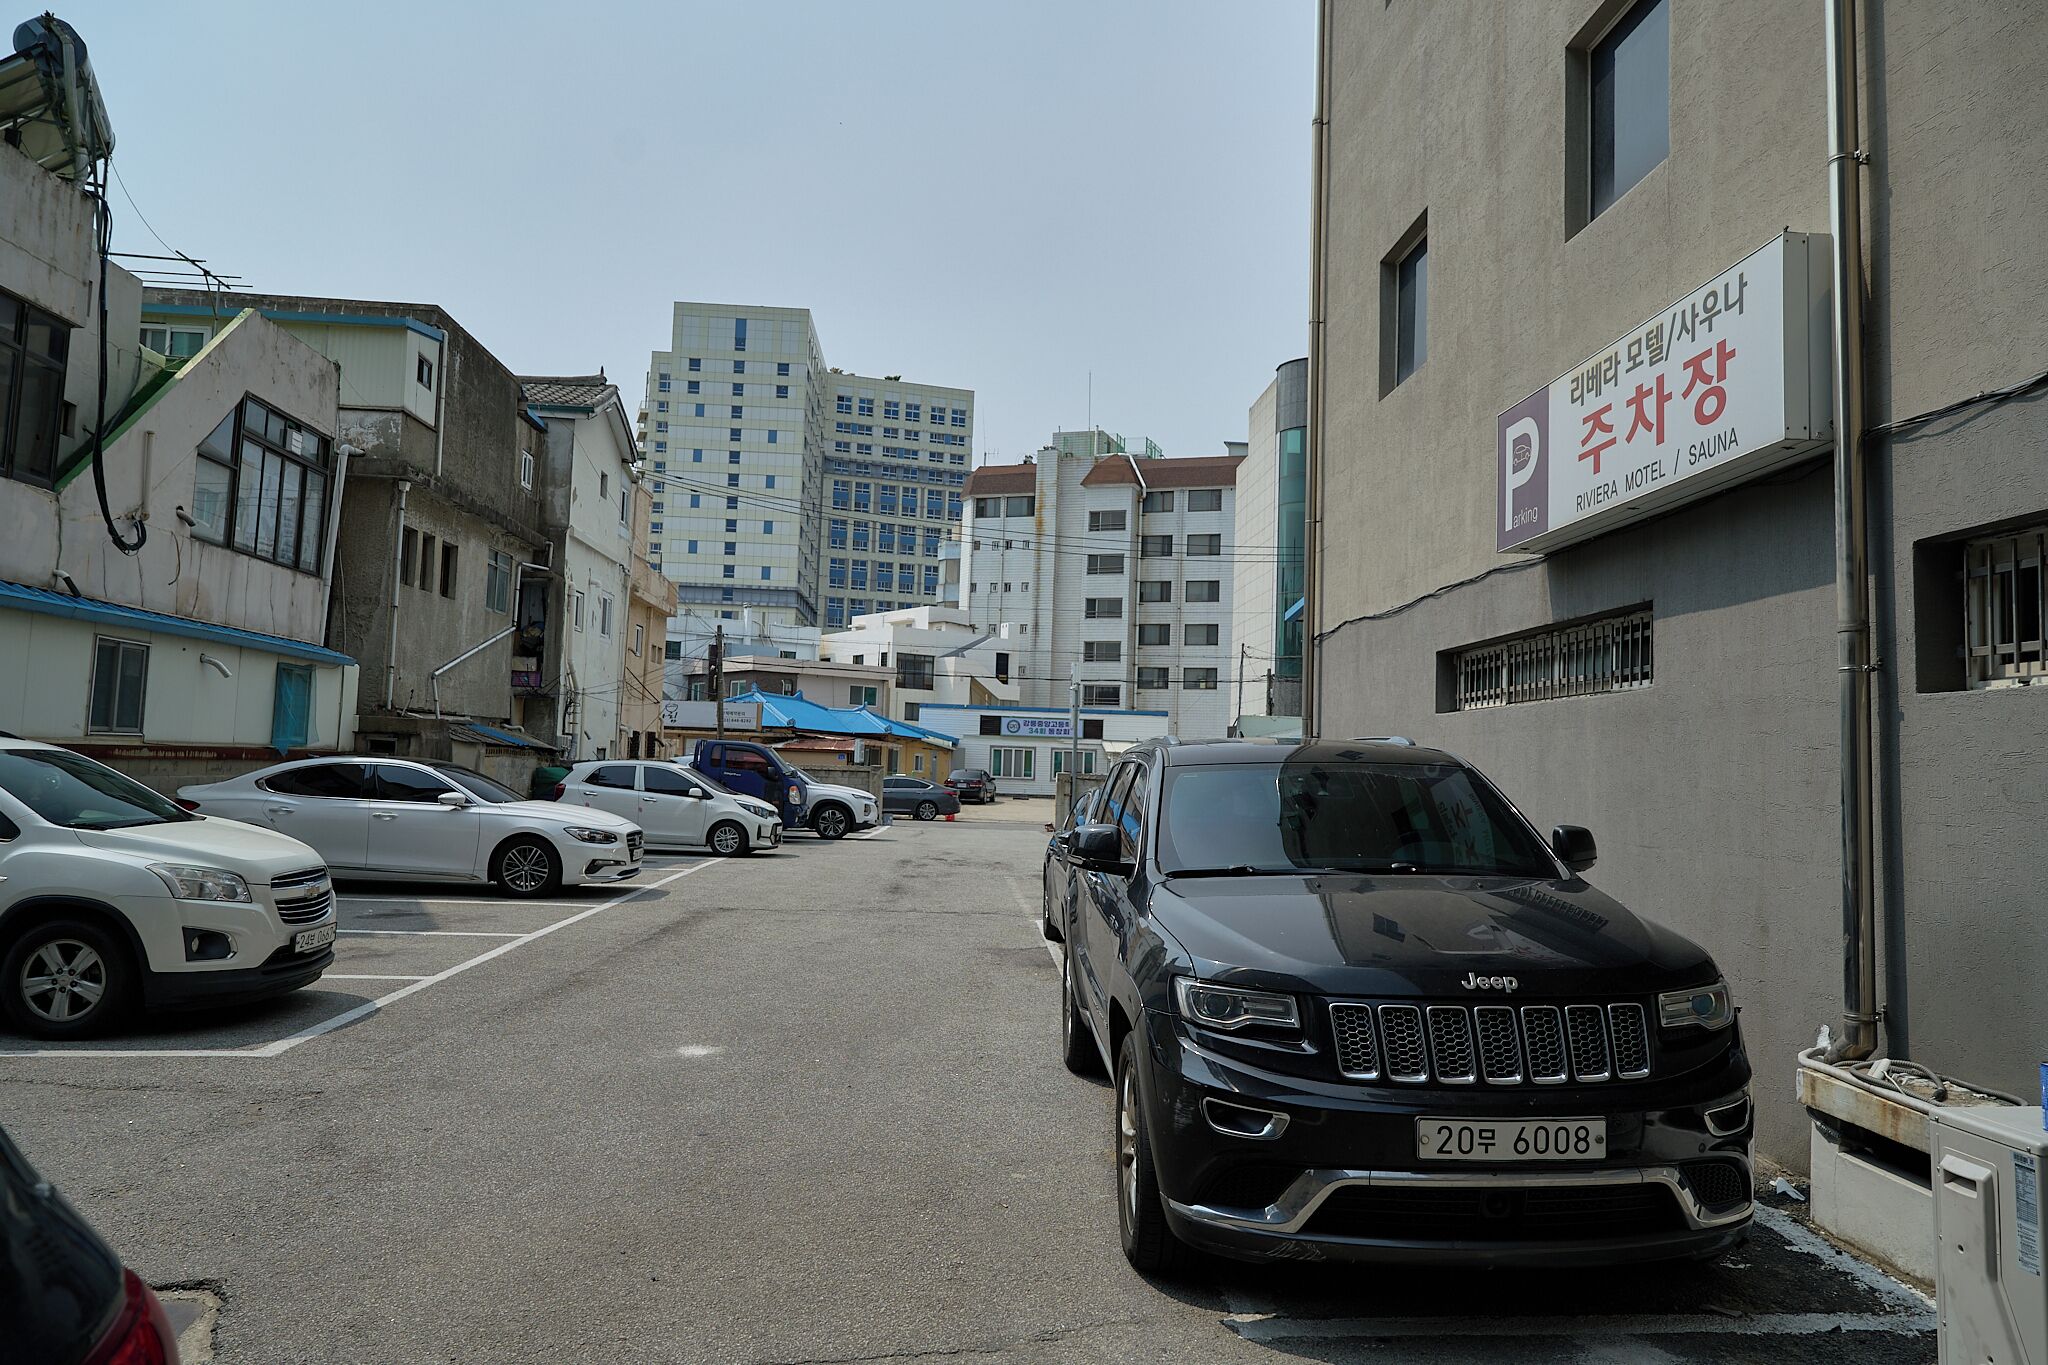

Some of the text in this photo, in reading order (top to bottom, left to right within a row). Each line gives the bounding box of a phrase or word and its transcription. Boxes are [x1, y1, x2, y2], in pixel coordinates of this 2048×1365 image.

[1570, 272, 1748, 407] 리베라 모텔/사우나
[1578, 338, 1736, 476] 주차장
[1576, 480, 1618, 513] RIVIERA
[1625, 460, 1666, 493] MOTEL
[1688, 427, 1739, 466] SAUNA
[1461, 972, 1519, 994] Jeep
[1436, 1125, 1591, 1155] 20무 6008
